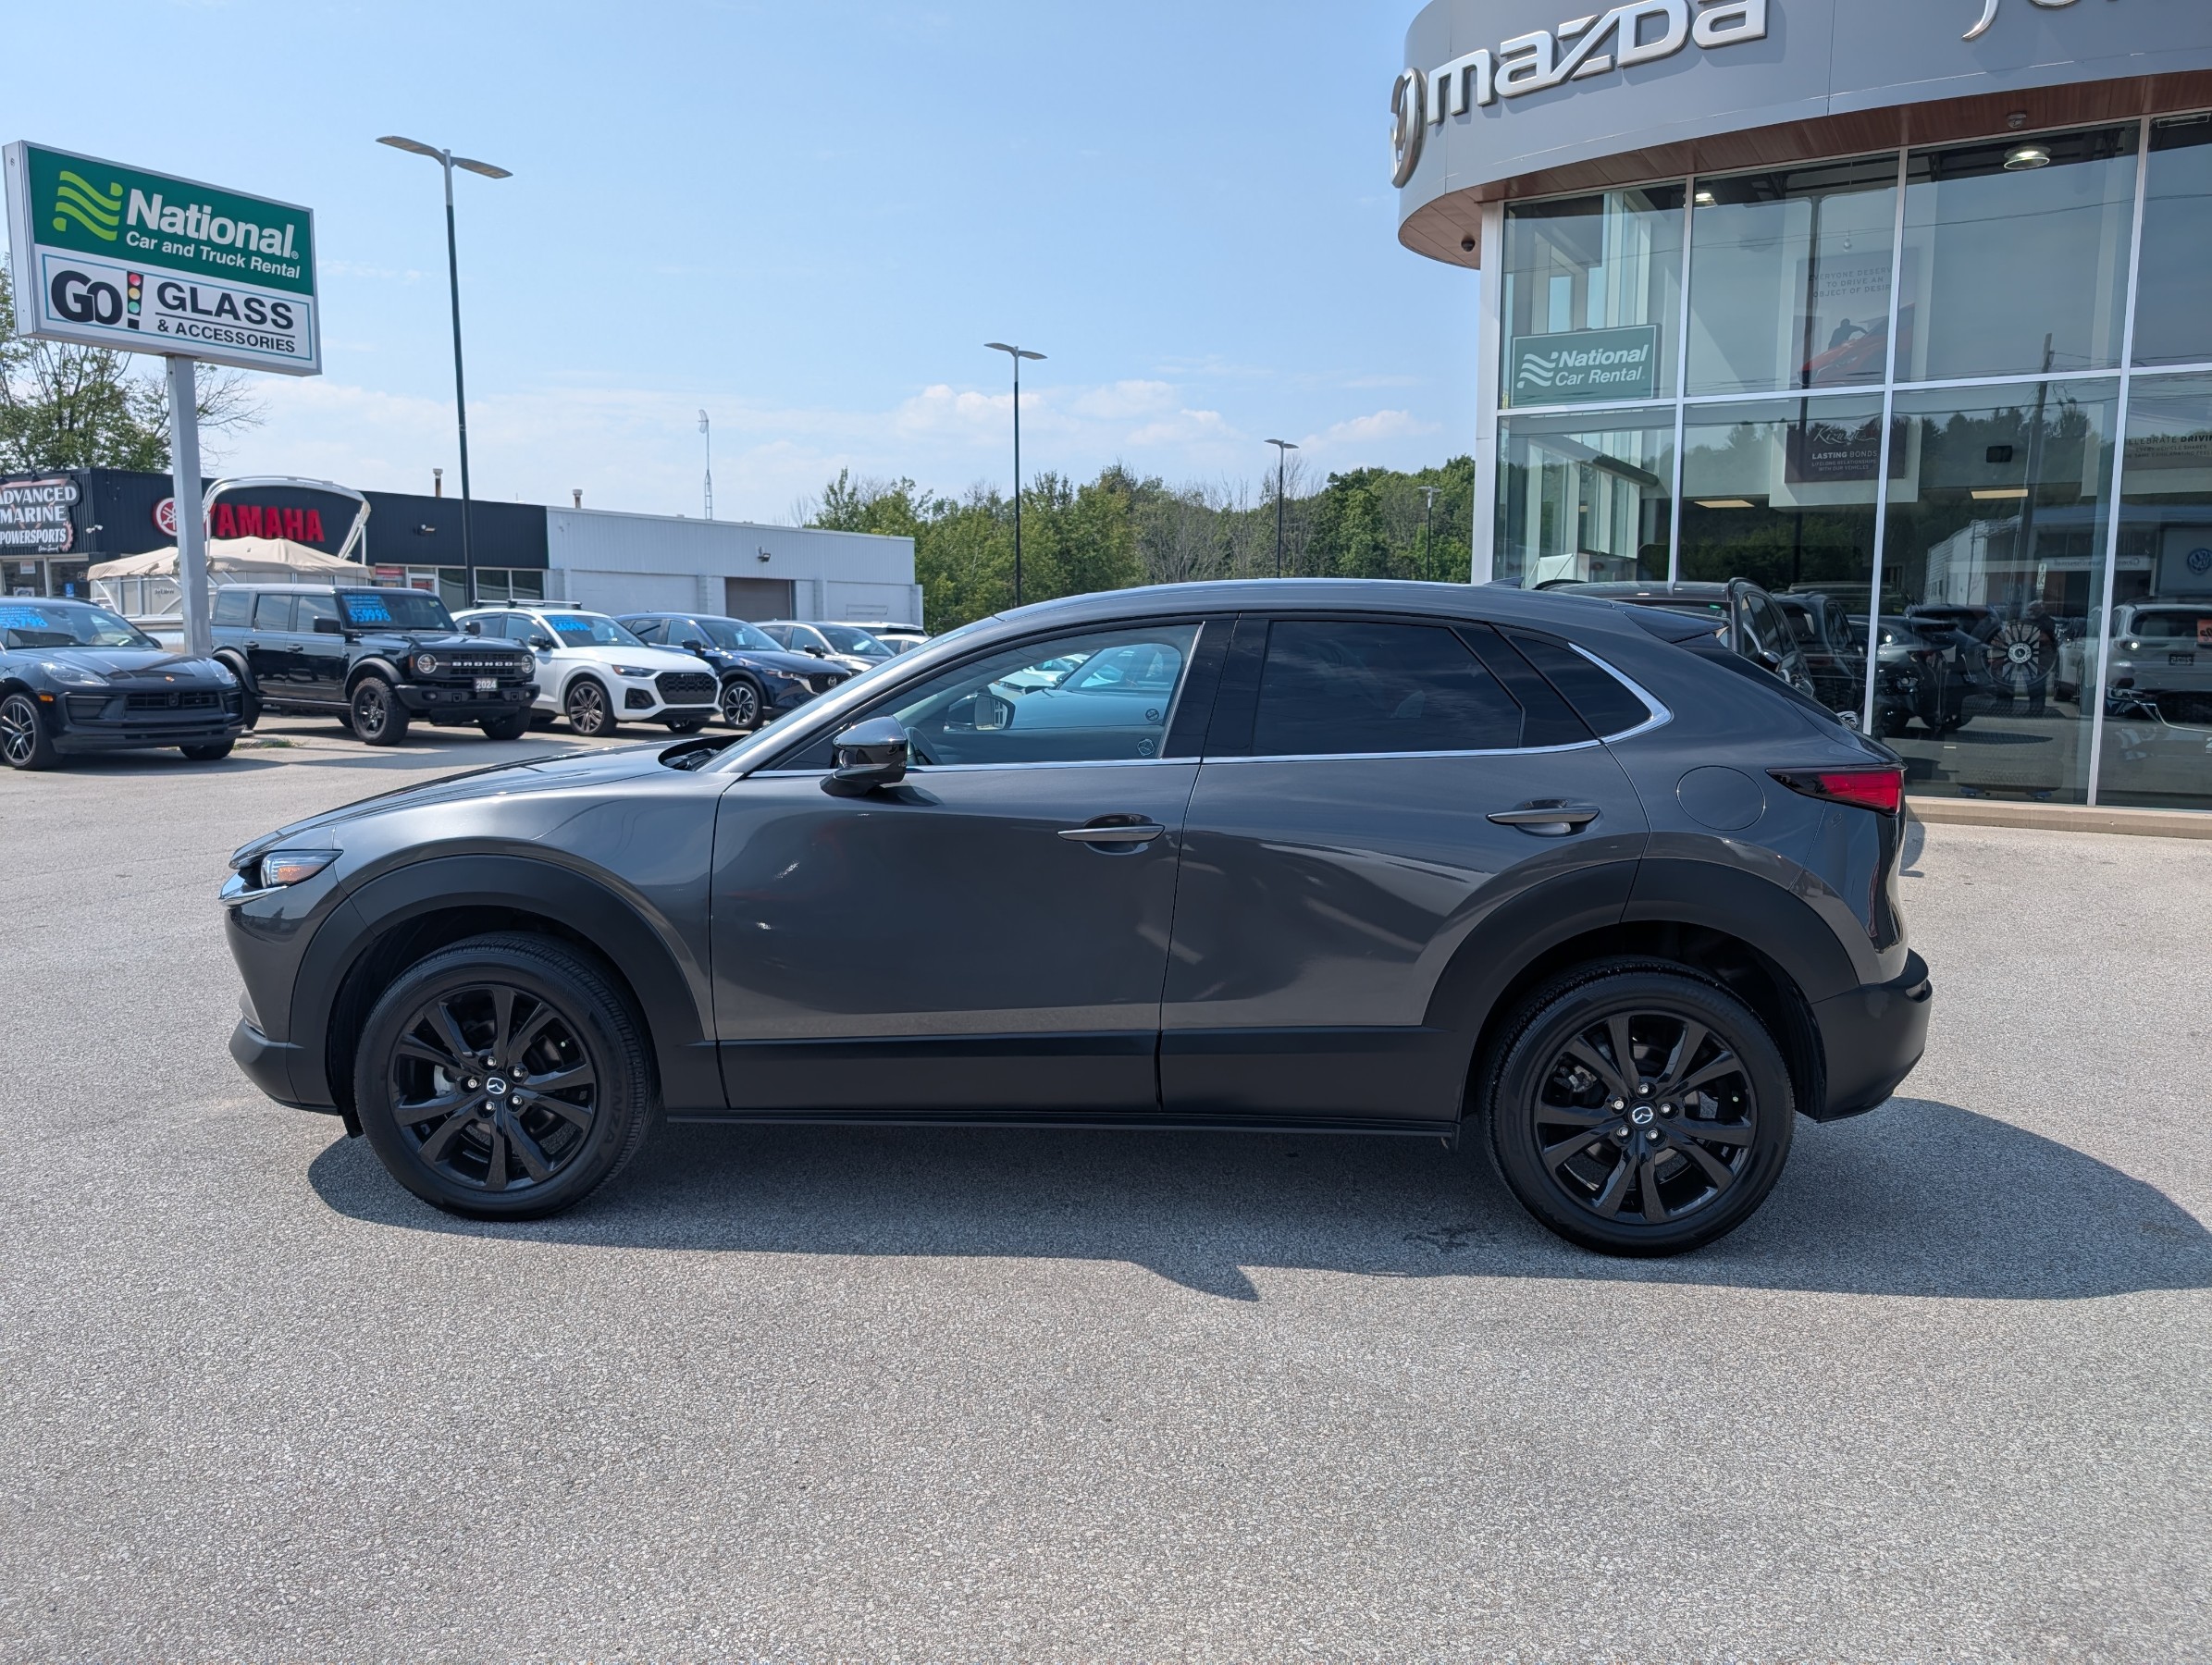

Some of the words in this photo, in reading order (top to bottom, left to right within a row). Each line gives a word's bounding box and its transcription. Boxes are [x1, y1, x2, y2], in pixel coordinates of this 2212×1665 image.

[126, 231, 157, 251] Car
[162, 240, 194, 259] and
[200, 246, 245, 268] Truck
[250, 256, 300, 279] Rental
[1858, 266, 1893, 277] DESERV
[1813, 288, 1847, 298] OBJECT
[1865, 283, 1892, 292] DESIR
[1841, 278, 1868, 287] DRIVE
[156, 281, 294, 330] GLASS
[157, 319, 169, 332] &
[175, 322, 295, 353] ACCESSORIES
[1559, 344, 1650, 368] National
[1555, 371, 1585, 387] Car
[1588, 366, 1642, 384] Rental
[2126, 436, 2177, 445] ELEBRATE
[1812, 451, 1847, 460] LASTING
[0, 505, 67, 524] MARINE
[0, 528, 67, 545] POWERSPORTS
[476, 680, 497, 689] 2024
